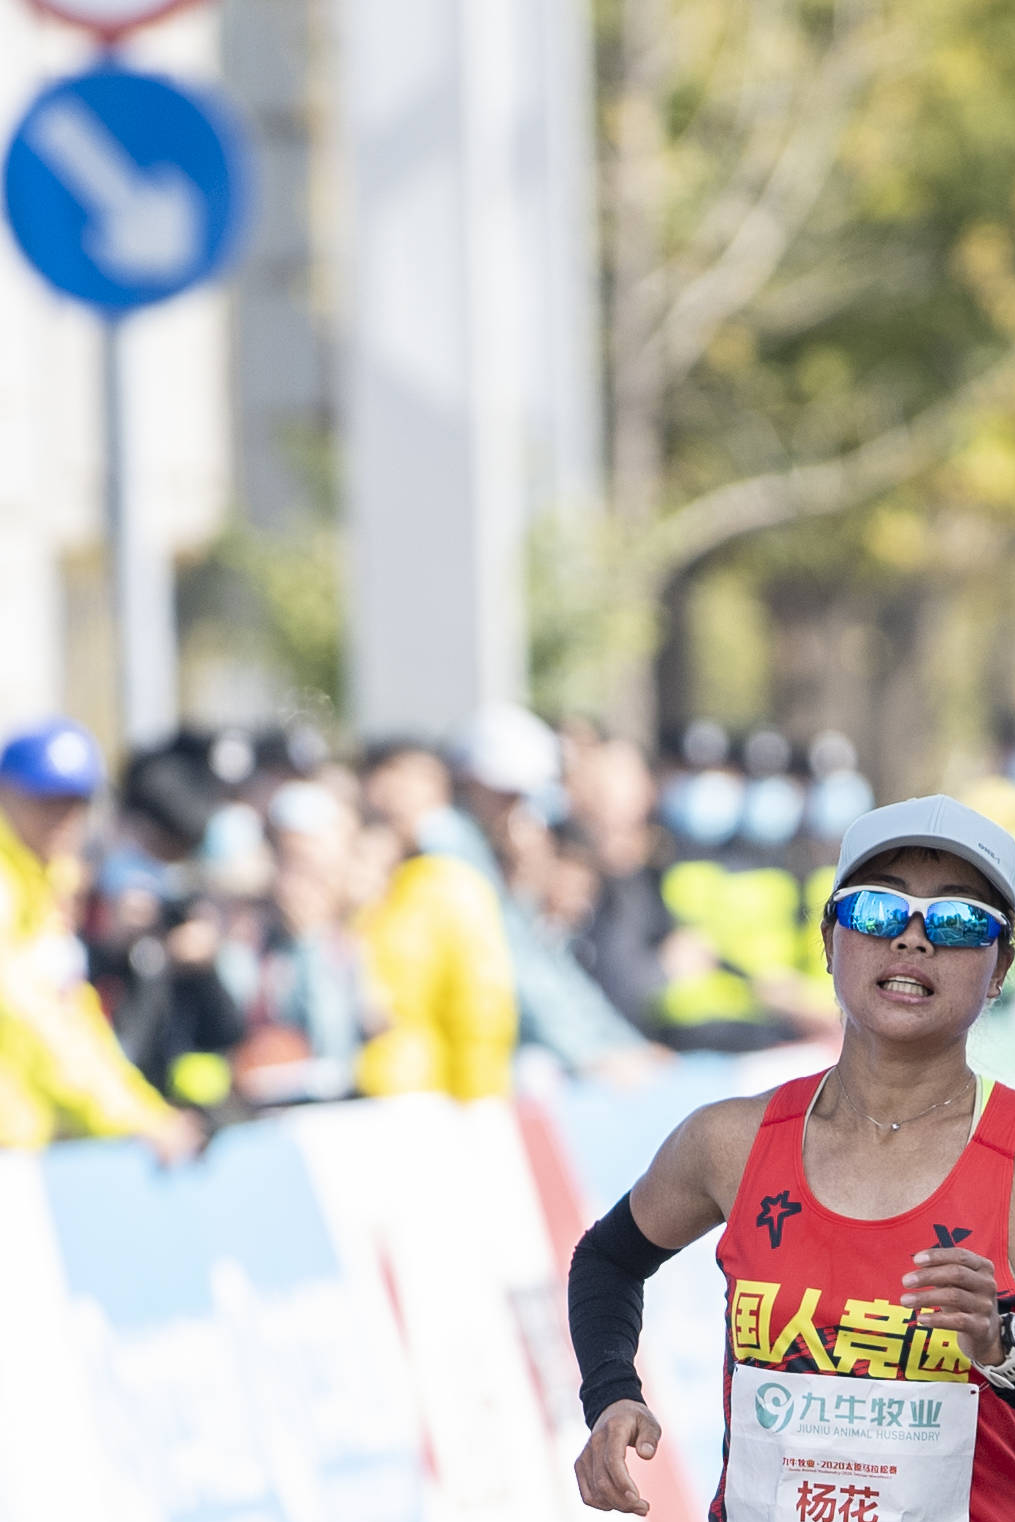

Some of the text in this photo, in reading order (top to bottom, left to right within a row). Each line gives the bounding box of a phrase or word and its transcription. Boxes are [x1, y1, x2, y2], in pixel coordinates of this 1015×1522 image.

[799, 1392, 943, 1428] 九牛牧业
[797, 1424, 941, 1442] JIUNIU ANIMAL HUSBANDRY
